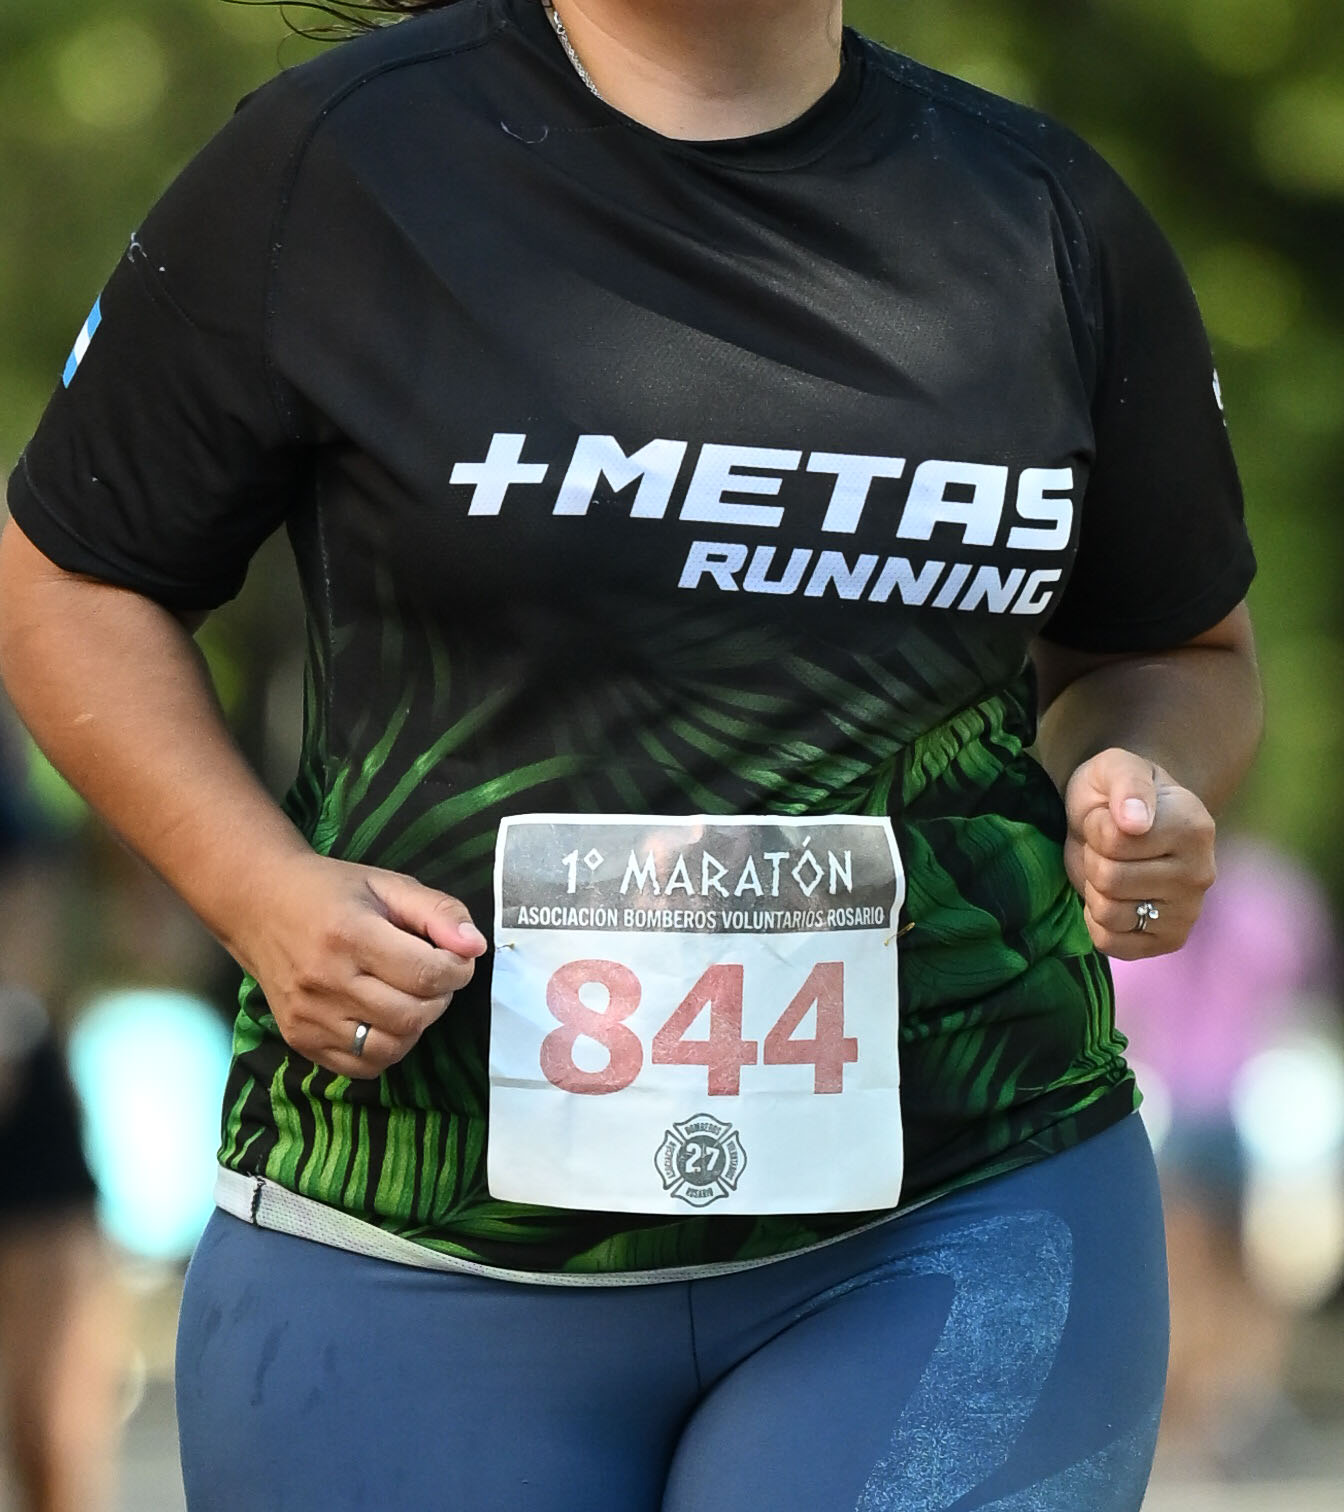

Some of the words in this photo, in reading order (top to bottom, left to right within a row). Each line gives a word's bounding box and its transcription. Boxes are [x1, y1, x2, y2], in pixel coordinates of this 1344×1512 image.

[449, 433, 1075, 551] +METAS
[677, 540, 1063, 615] RUNNING
[619, 835, 853, 898] MARATÓN
[518, 904, 618, 927] ASOCIACIÓN
[624, 908, 717, 929] BOMBEROS
[722, 909, 823, 930] VOLUNTARIOS
[827, 905, 885, 926] ROSARIO
[539, 959, 859, 1097] 844
[685, 1142, 720, 1173] 27
